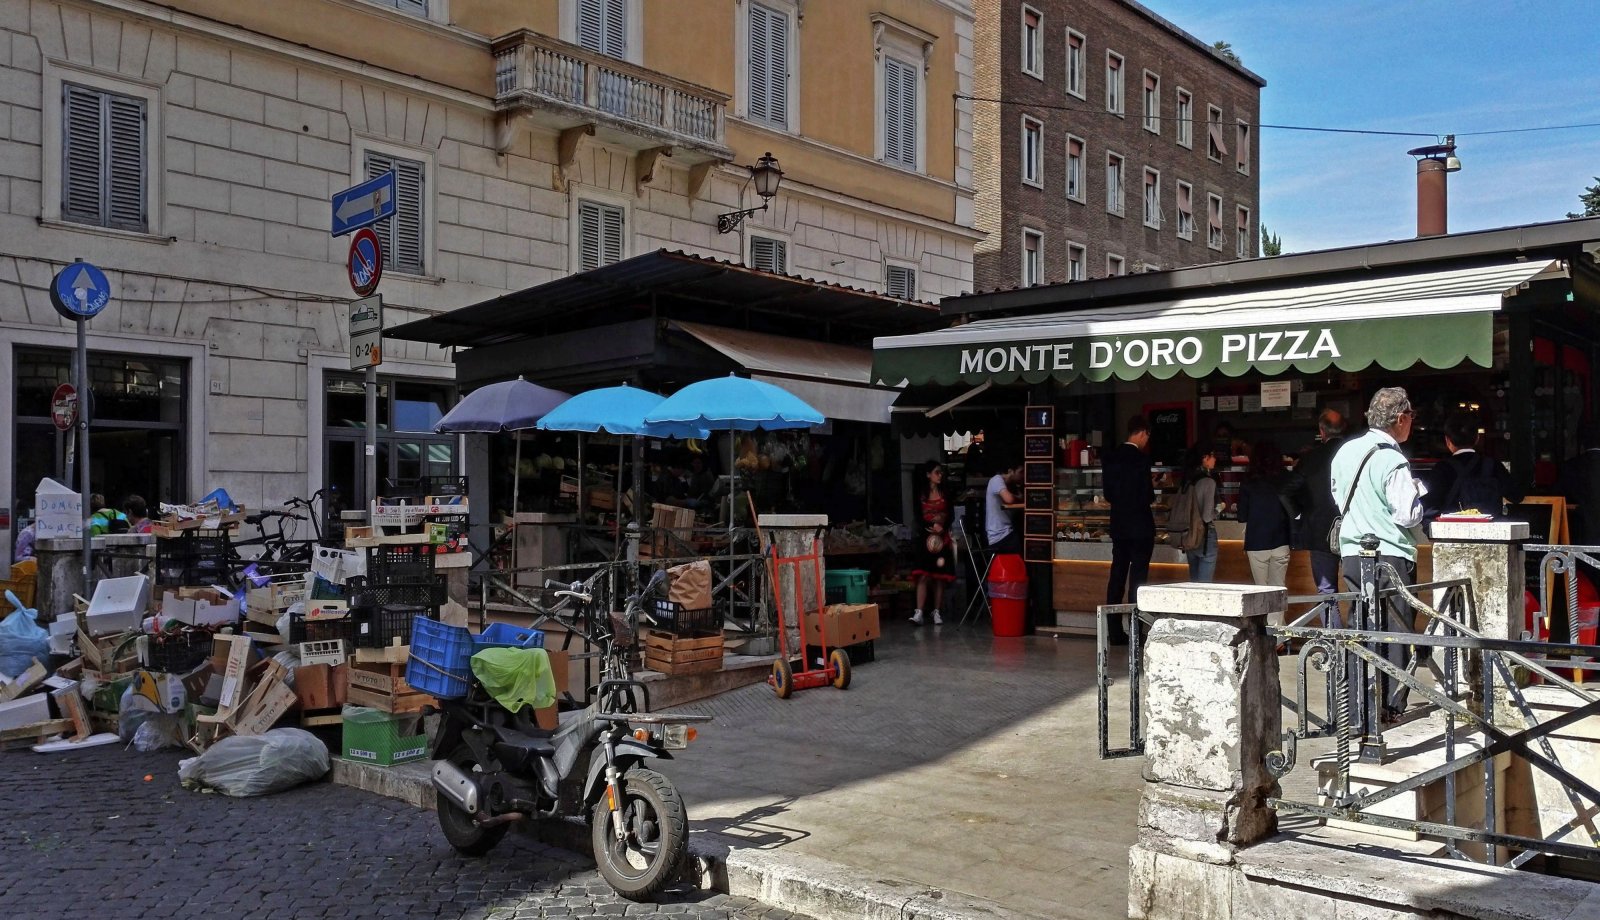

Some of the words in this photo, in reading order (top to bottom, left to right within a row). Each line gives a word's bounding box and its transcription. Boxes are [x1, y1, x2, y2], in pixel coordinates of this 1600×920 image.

[960, 343, 1074, 375] MONTE
[1089, 335, 1203, 369] D'ORO
[1221, 328, 1341, 364] PIZZA
